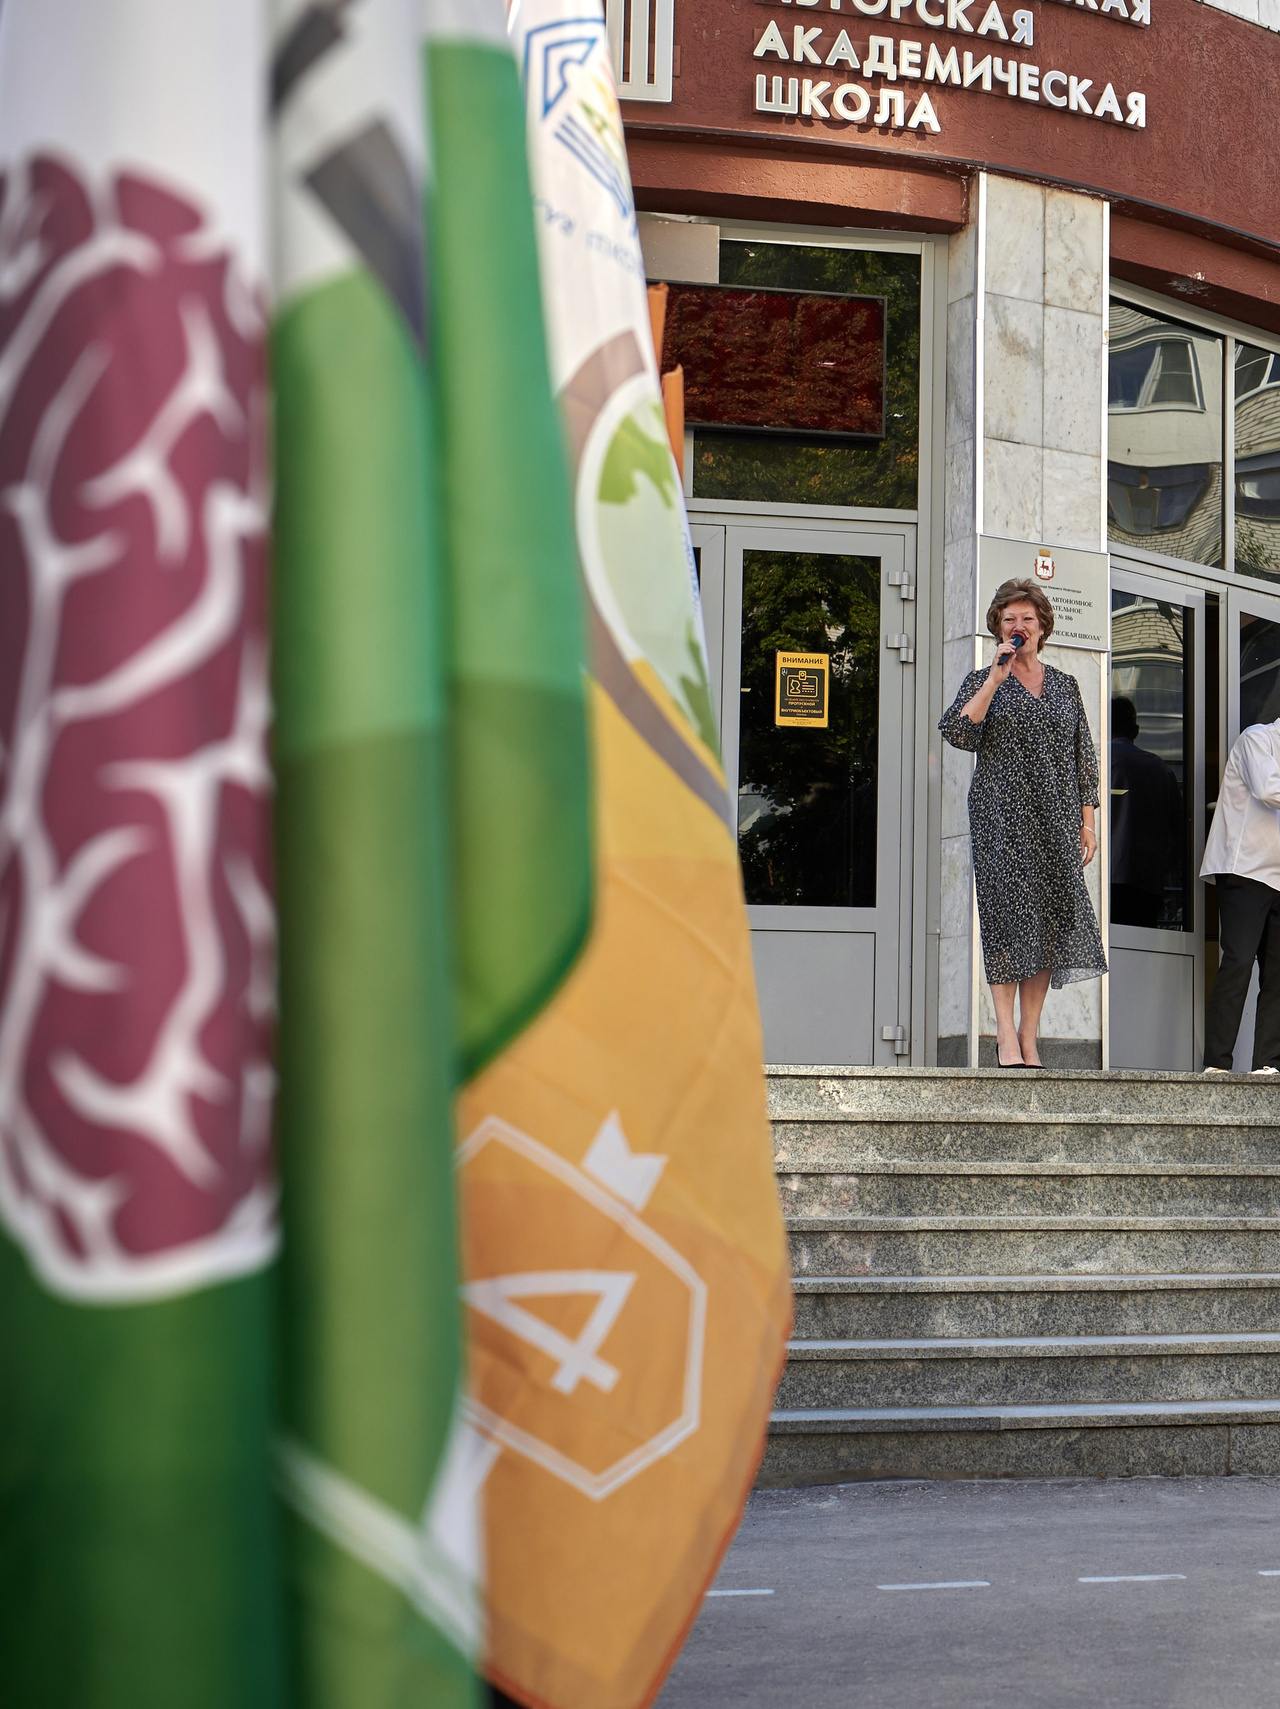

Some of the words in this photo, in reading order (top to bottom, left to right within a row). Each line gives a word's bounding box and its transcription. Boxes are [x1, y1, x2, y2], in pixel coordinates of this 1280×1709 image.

[753, 20, 1147, 128] АКАДЕМИЧЕСКАЯ
[755, 74, 941, 133] ШКОЛА
[1052, 597, 1093, 607] АВТОНОМНОЕ
[462, 1269, 638, 1395] 4
